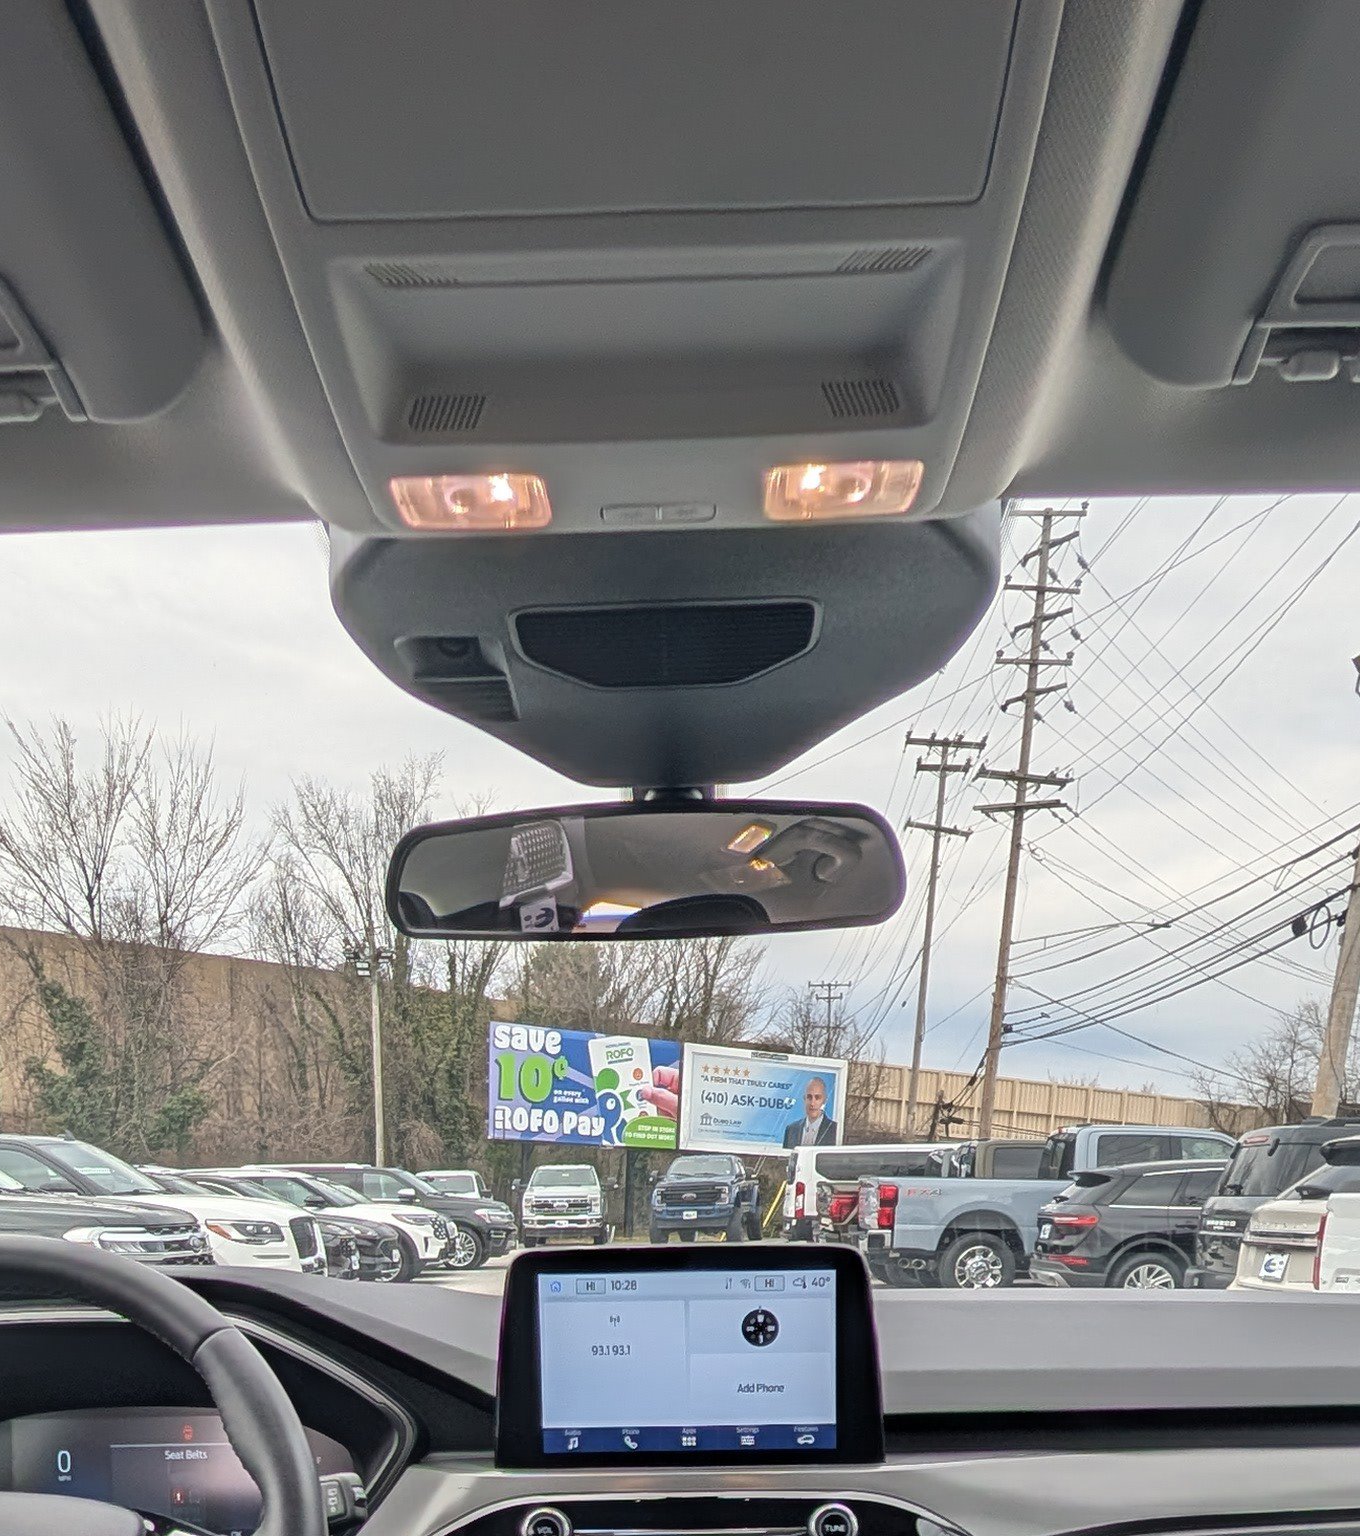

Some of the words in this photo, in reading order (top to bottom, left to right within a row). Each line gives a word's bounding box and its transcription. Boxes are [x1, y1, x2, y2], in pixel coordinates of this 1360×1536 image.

[606, 1047, 634, 1060] ROFO
[728, 1077, 746, 1086] THAT
[747, 1079, 768, 1088] TRULY
[700, 1089, 729, 1106] (410)
[494, 1106, 560, 1134] ROFO
[562, 1110, 606, 1138] Pay
[610, 1280, 637, 1291] 10:28
[811, 1277, 831, 1287] 40°
[591, 1345, 610, 1356] 93.1
[612, 1344, 631, 1356] 93.1
[737, 1382, 755, 1393] Add
[756, 1382, 785, 1394] Phone
[736, 1426, 760, 1435] Settings
[57, 1449, 71, 1475] 0
[165, 1450, 184, 1461] Seat
[186, 1449, 209, 1461] Belts
[536, 1526, 552, 1535] VOL
[824, 1524, 846, 1533] TUNE
